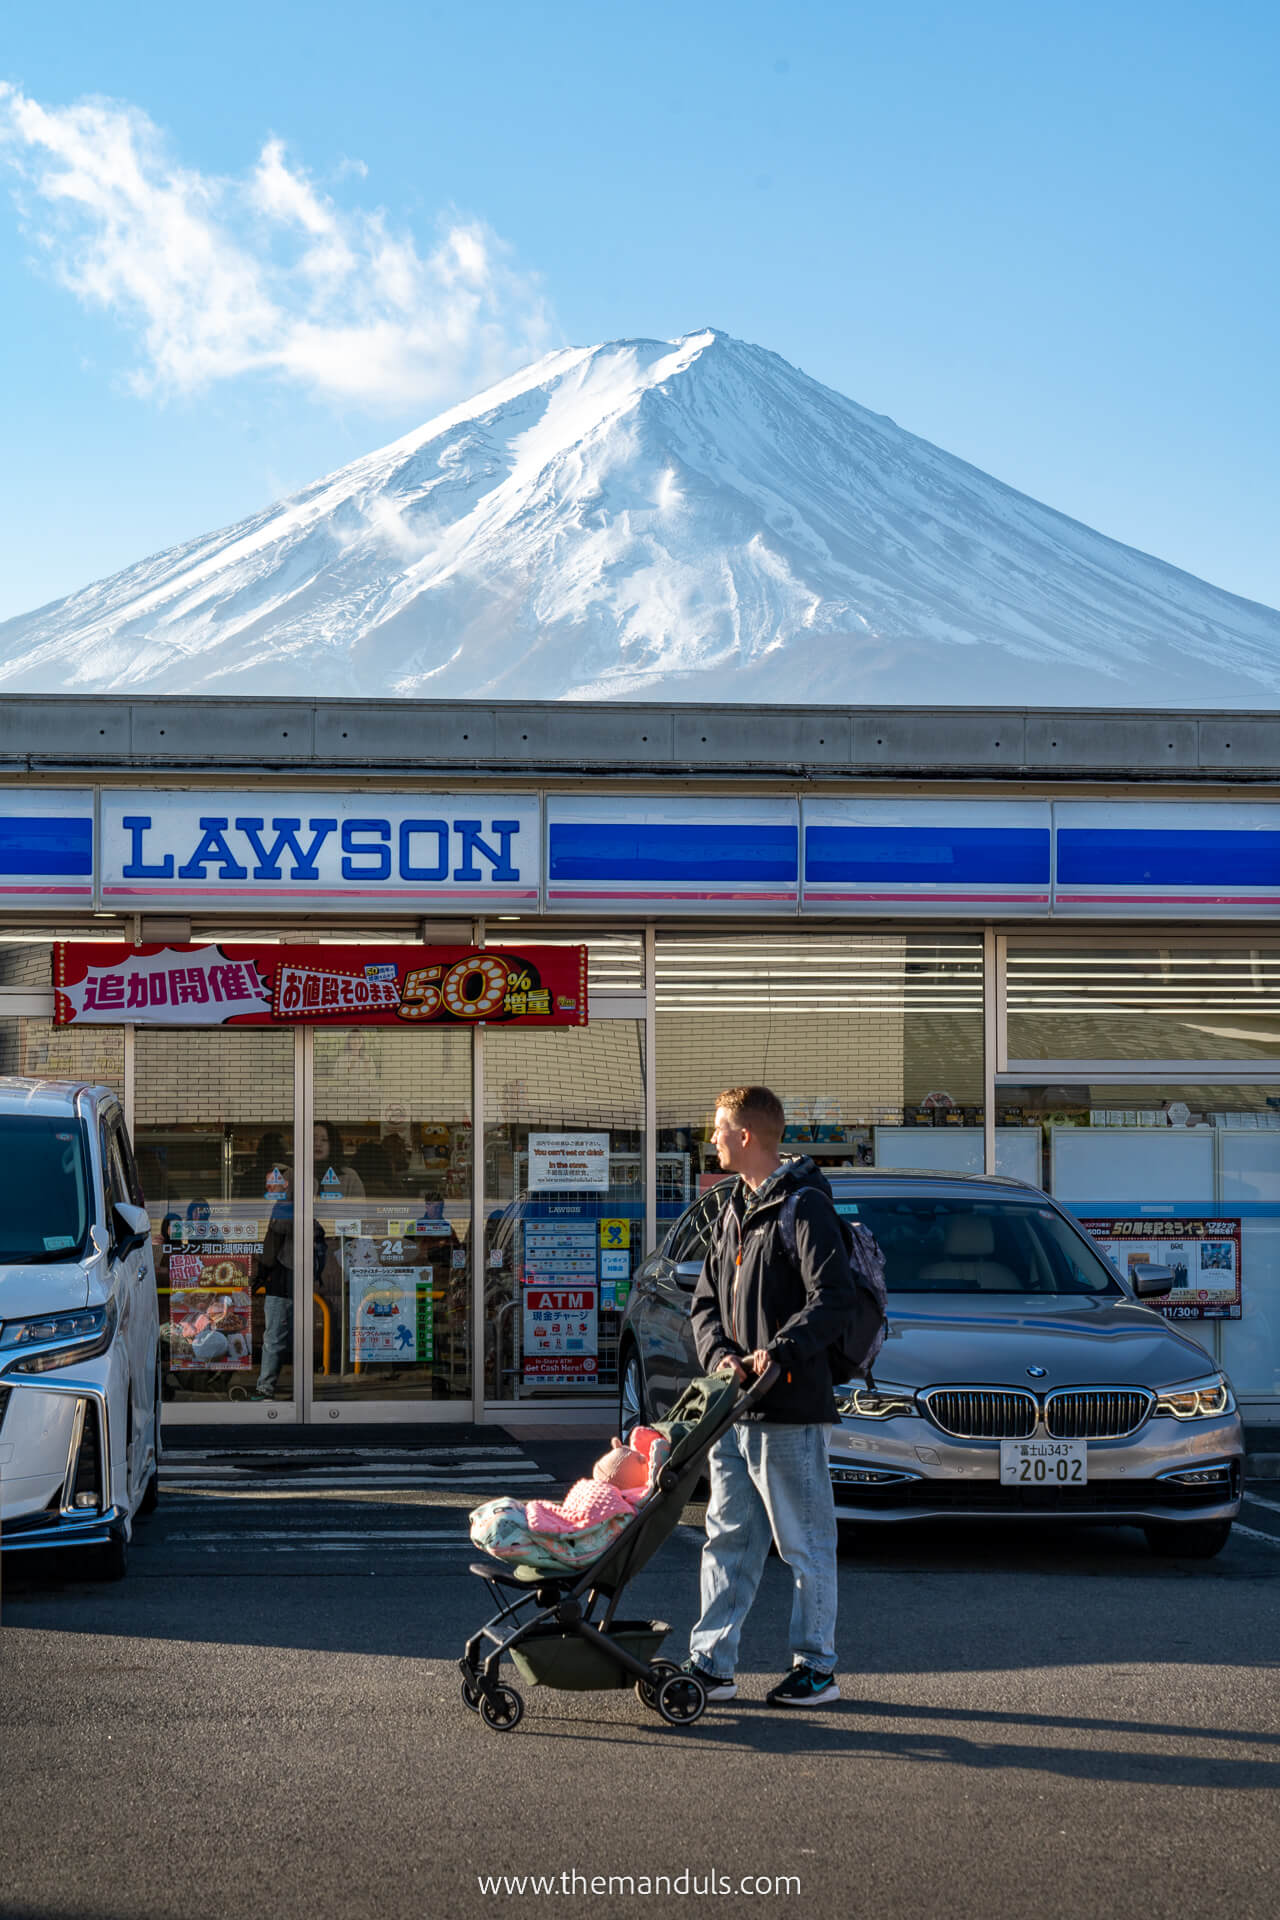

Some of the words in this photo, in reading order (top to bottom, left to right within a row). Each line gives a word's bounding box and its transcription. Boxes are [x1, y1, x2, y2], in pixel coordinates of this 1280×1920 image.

[122, 815, 521, 882] LAWSON
[82, 962, 265, 1012] 追加開催!
[283, 972, 397, 1009] お値段そのまま
[503, 988, 551, 1015] 増量
[162, 1243, 201, 1254] ローソン
[201, 1243, 264, 1254] 河口湖駅前店
[381, 1240, 404, 1255] 24
[538, 1293, 584, 1308] ATM
[532, 1311, 589, 1321] 現金チャージ
[1162, 1307, 1190, 1318] 11/30
[526, 1364, 539, 1372] Get
[540, 1364, 560, 1372] Cash
[561, 1364, 583, 1372] Here!
[1020, 1458, 1082, 1481] 20-02
